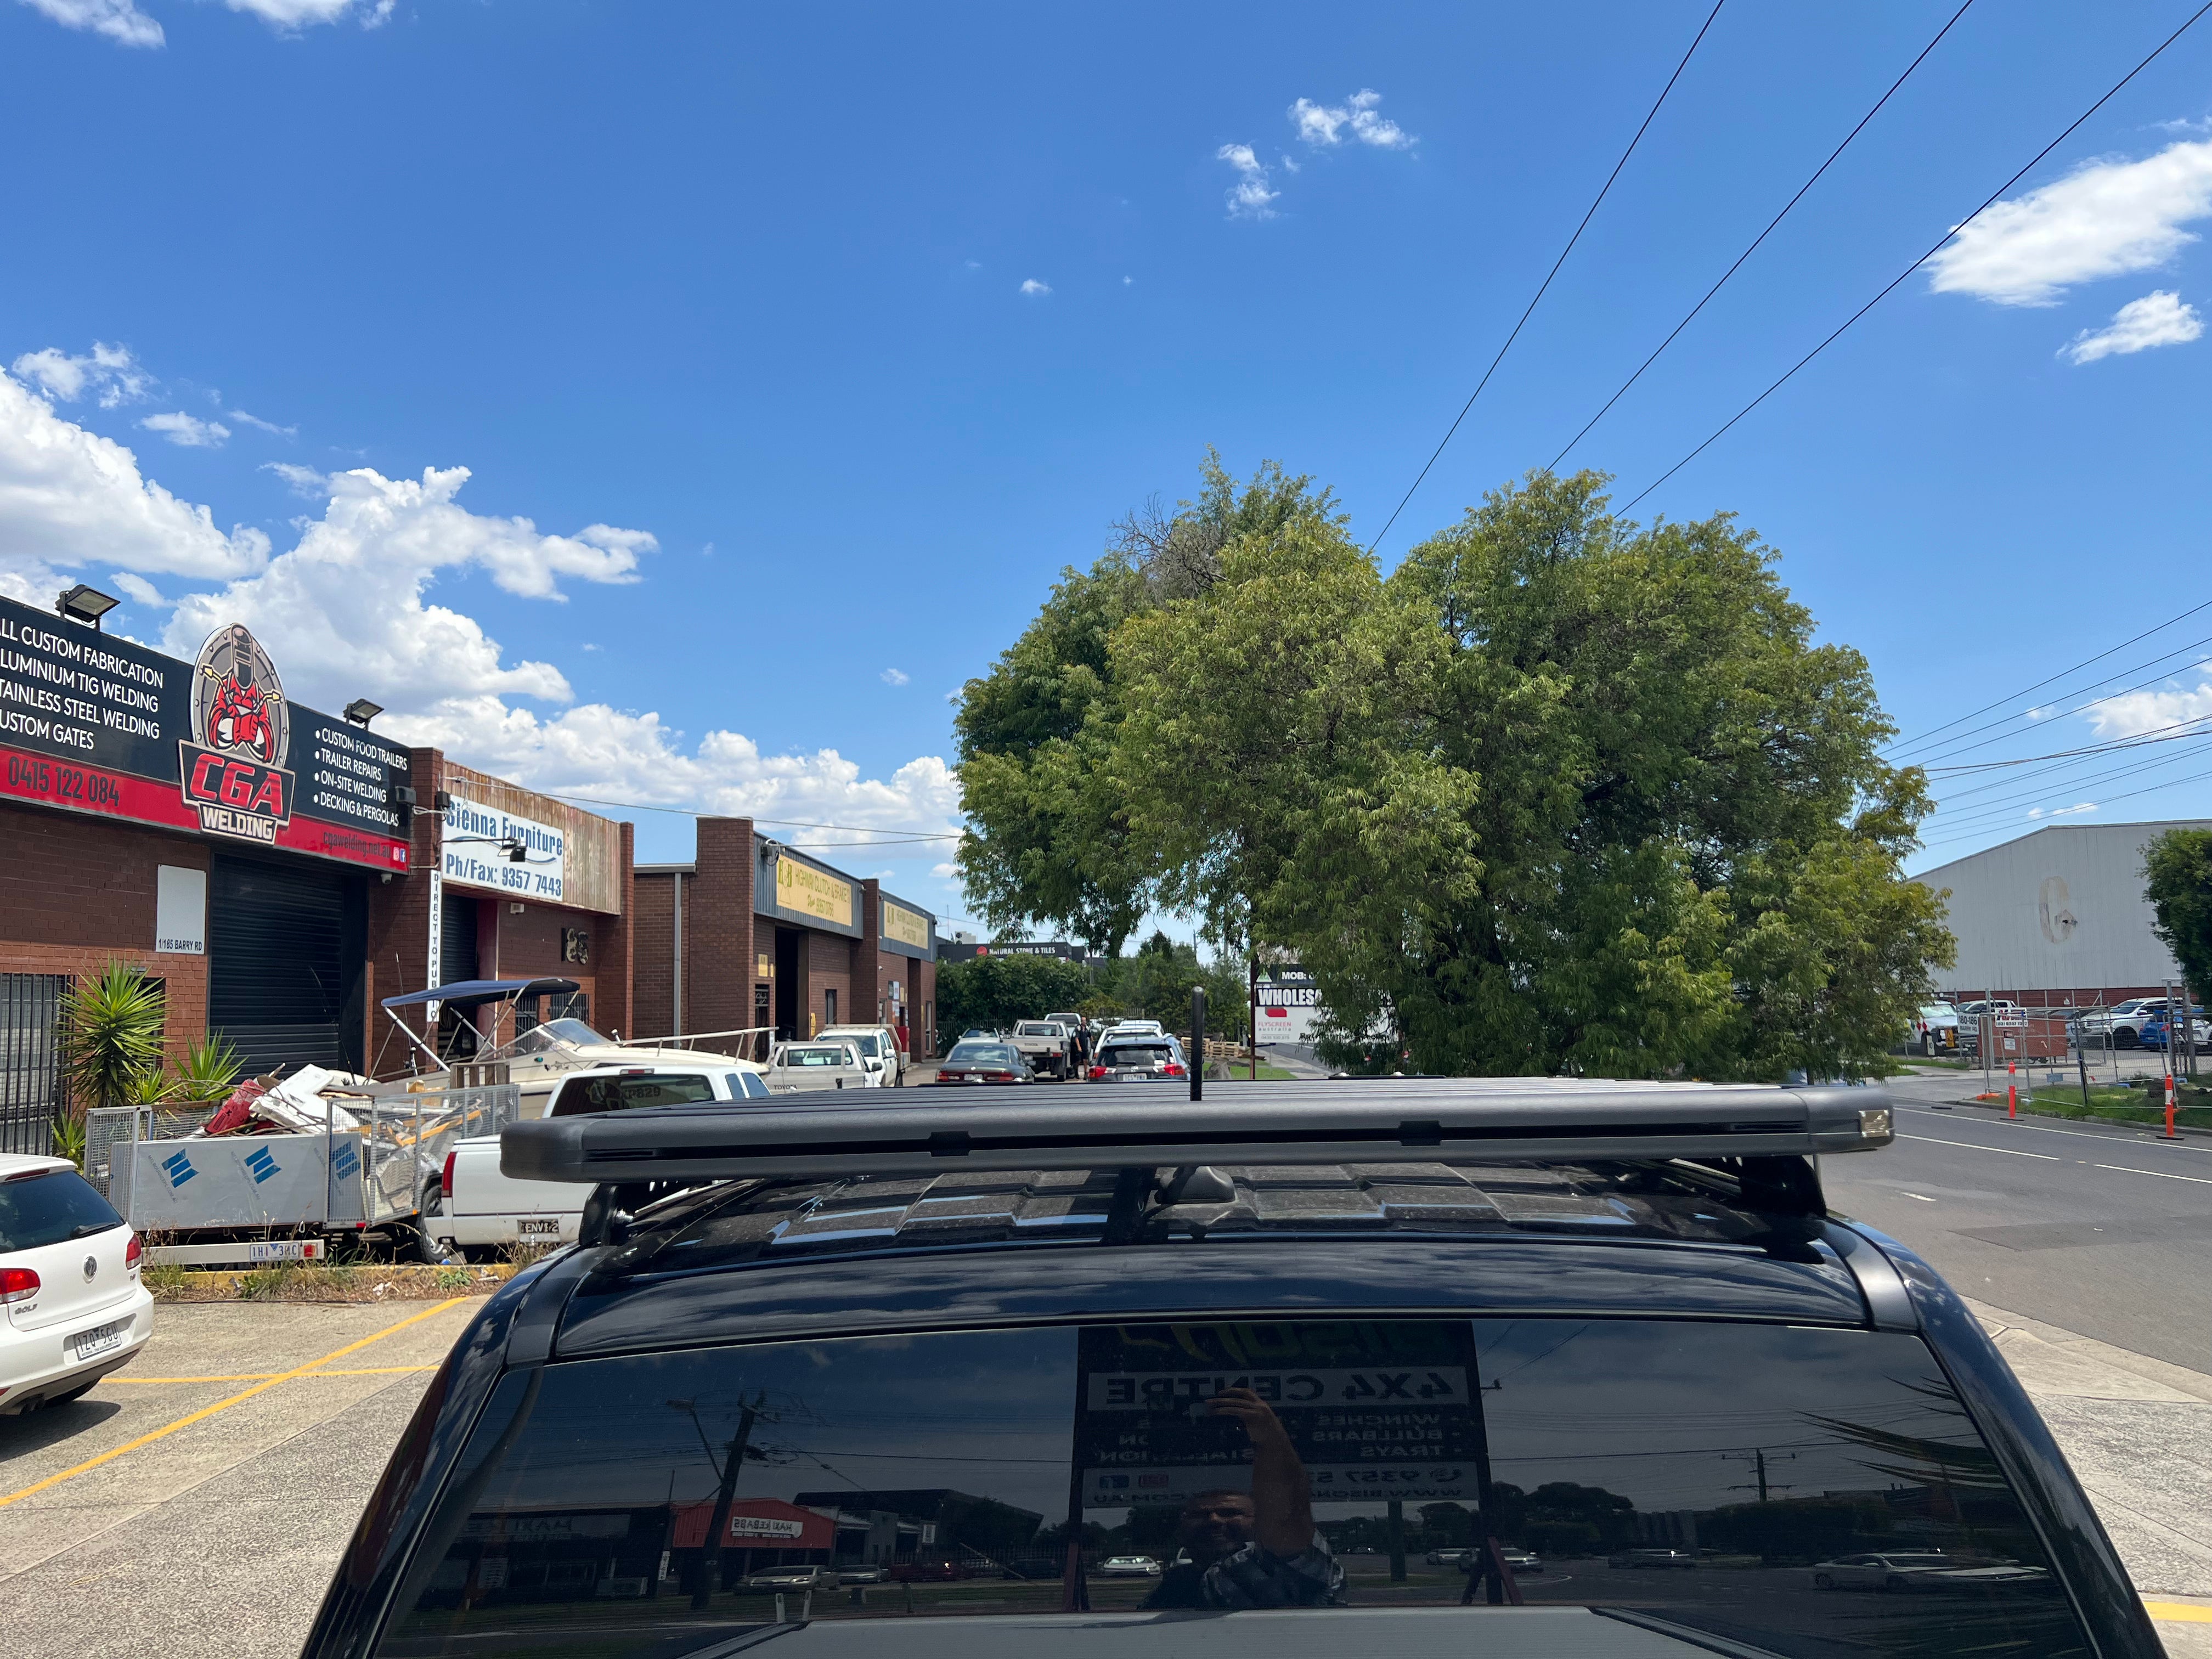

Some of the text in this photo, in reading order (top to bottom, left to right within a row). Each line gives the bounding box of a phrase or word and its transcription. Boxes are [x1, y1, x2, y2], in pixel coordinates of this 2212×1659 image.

[0, 618, 163, 689] LL CUSTOM FABRICATION
[0, 678, 160, 740] TAINLESS STEEL WELDING
[77, 672, 99, 695] TIG
[101, 679, 159, 713] WELDING
[0, 709, 94, 750] USTOM GATES
[321, 748, 381, 781] TRAILER REPAIRS
[322, 728, 407, 771] CUSTOM FOOD TRAILERS
[8, 756, 119, 807] 0415 122 084
[190, 753, 283, 817] CGA
[321, 770, 386, 803] ON-SITE WELDING
[203, 806, 273, 839] WELDING
[320, 792, 399, 827] DECKING & PERGOLAS
[323, 831, 391, 858] cgawelding.net.au
[445, 800, 562, 856] Sienna Furniture
[446, 853, 562, 896] Ph/Fax: 9357 7443
[159, 938, 202, 951] 1/185 BARRY RD
[432, 937, 437, 955] TO
[1282, 972, 1307, 980] MOB:
[15, 1303, 38, 1314] GOLF
[77, 1333, 96, 1352] 1ZQ
